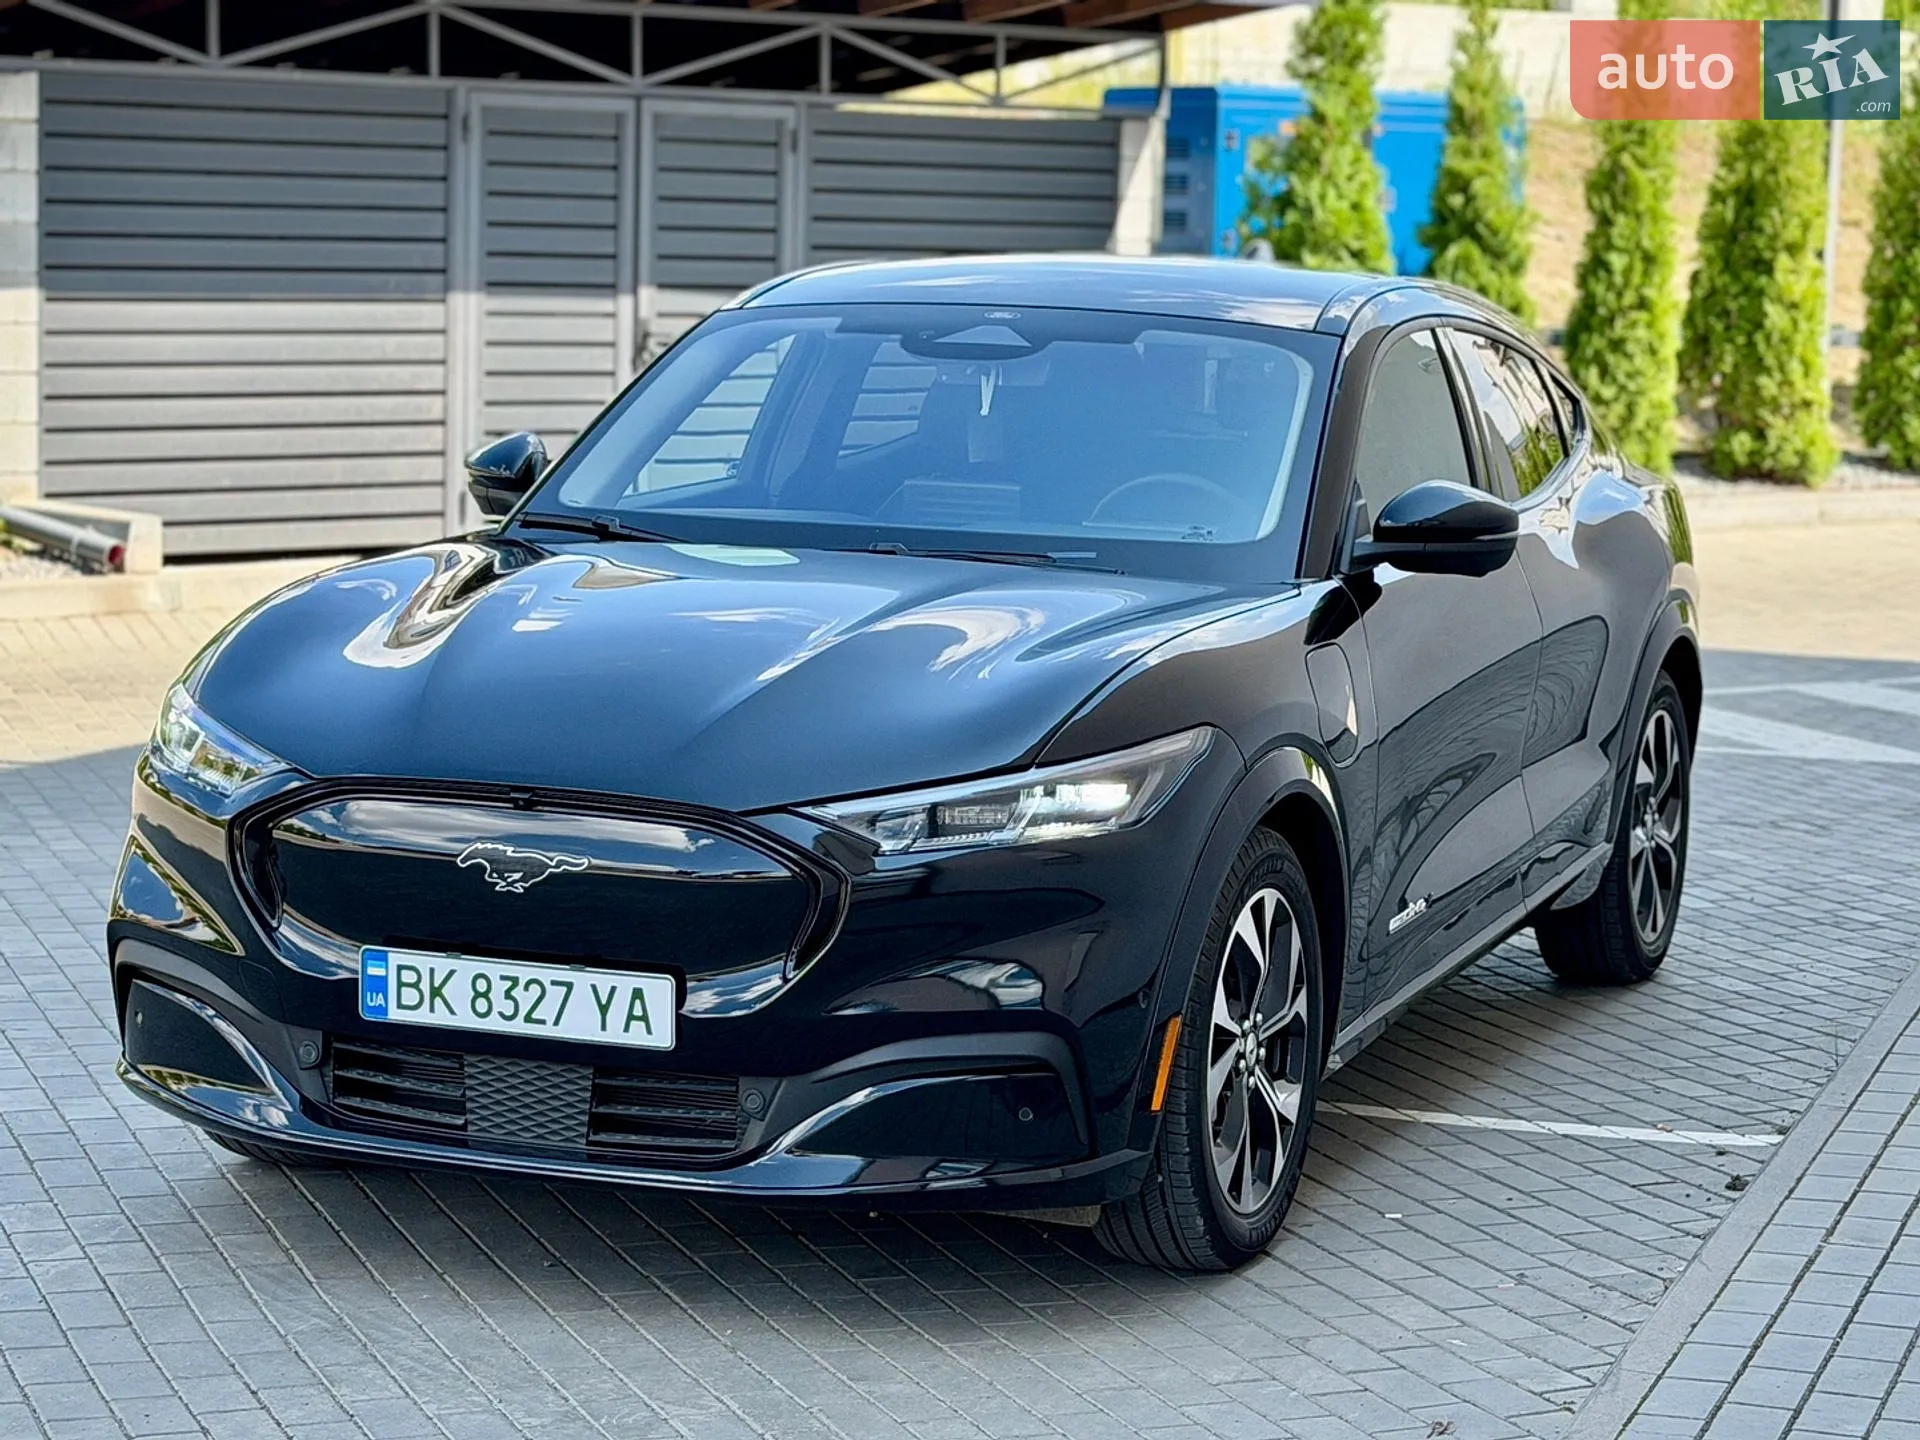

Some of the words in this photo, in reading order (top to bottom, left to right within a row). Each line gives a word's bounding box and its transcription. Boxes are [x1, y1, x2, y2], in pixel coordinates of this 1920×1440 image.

[366, 991, 387, 1008] UA
[395, 963, 458, 1017] BK
[469, 972, 575, 1027] 8327
[589, 983, 654, 1036] YA
